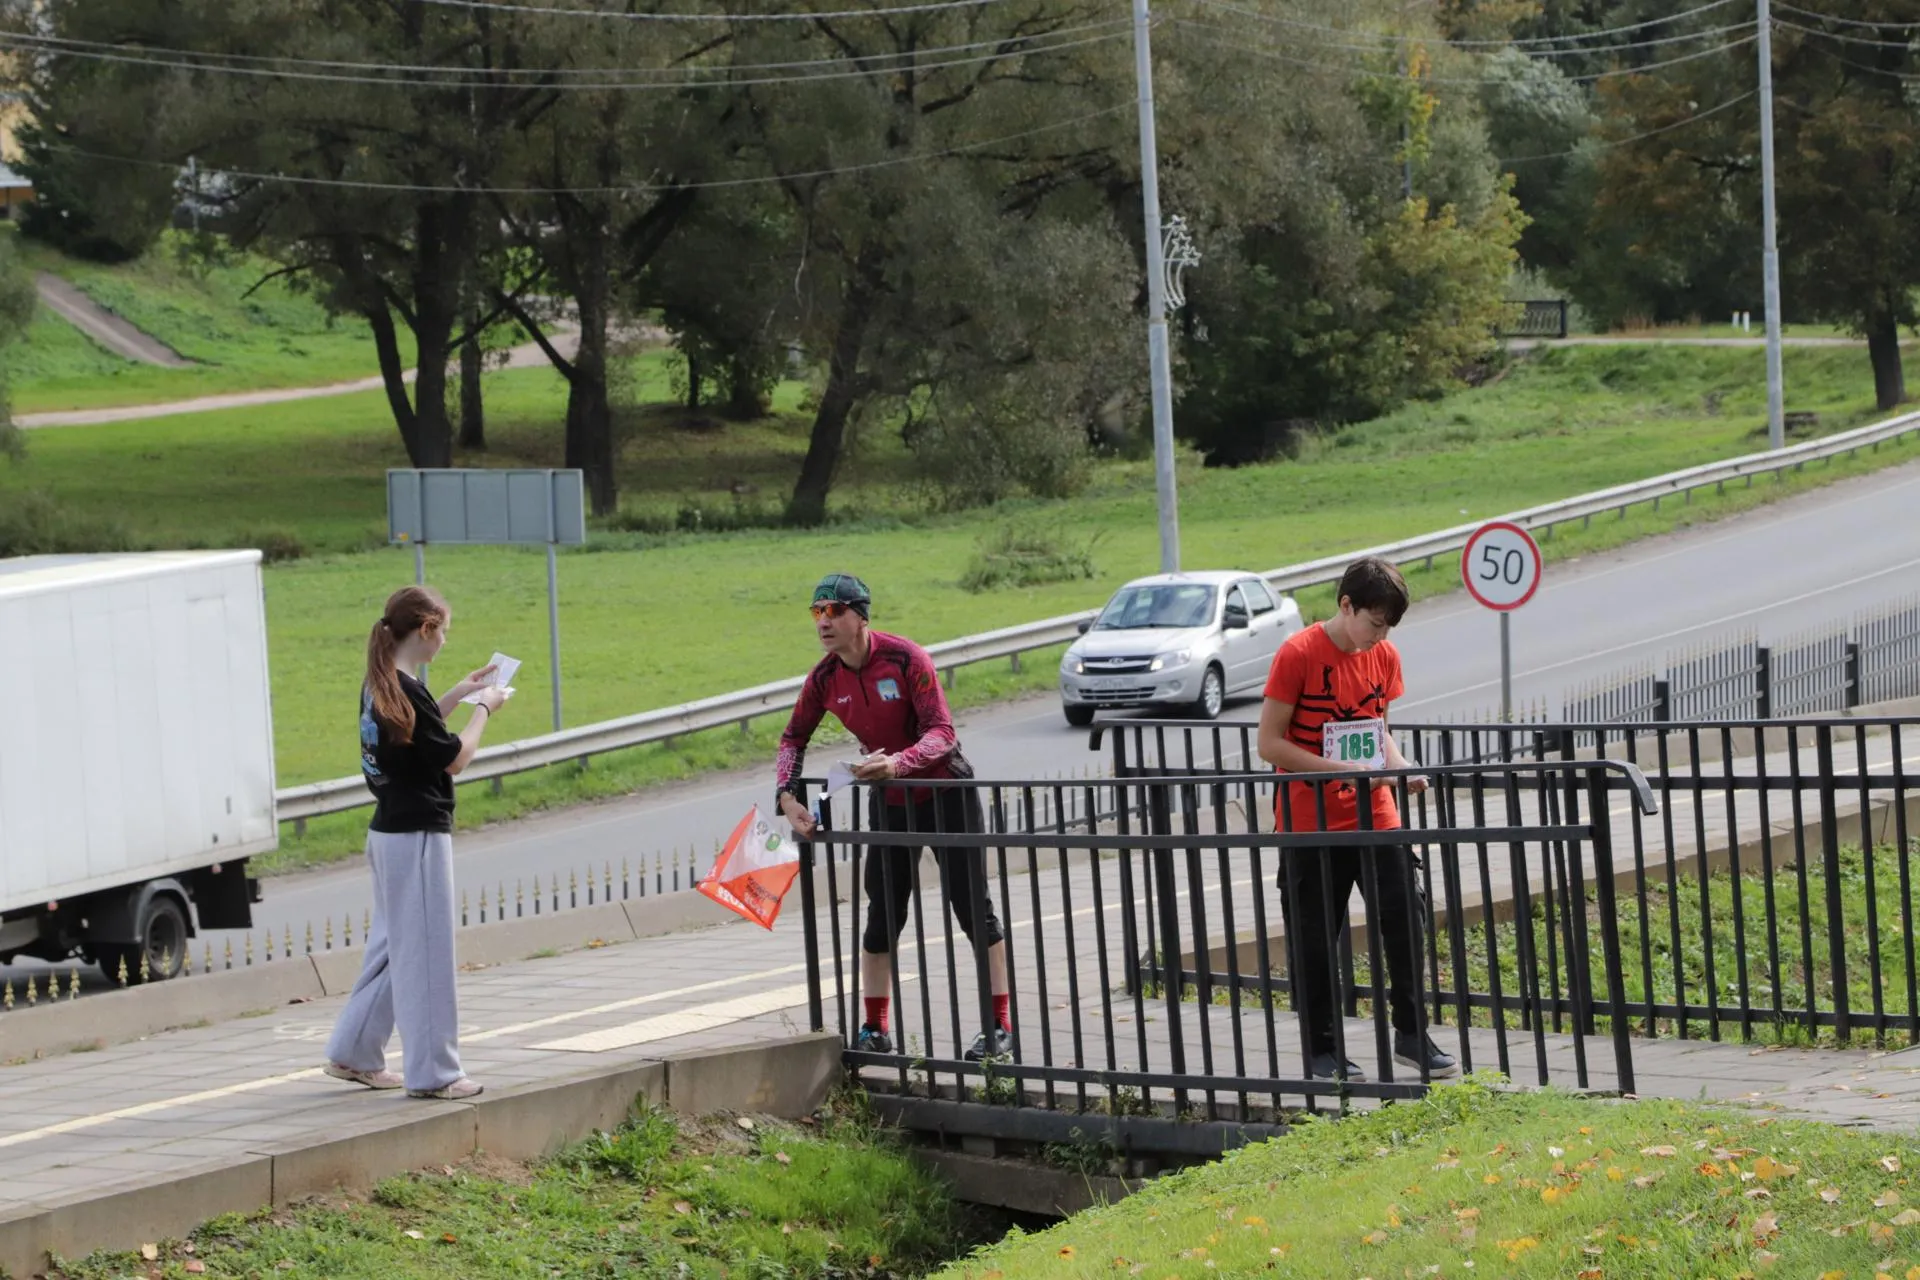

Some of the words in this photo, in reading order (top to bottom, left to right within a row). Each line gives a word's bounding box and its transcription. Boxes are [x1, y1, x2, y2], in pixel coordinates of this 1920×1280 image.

[1480, 544, 1524, 585] 50
[1325, 726, 1334, 759] КЛУ
[1337, 732, 1375, 760] 185
